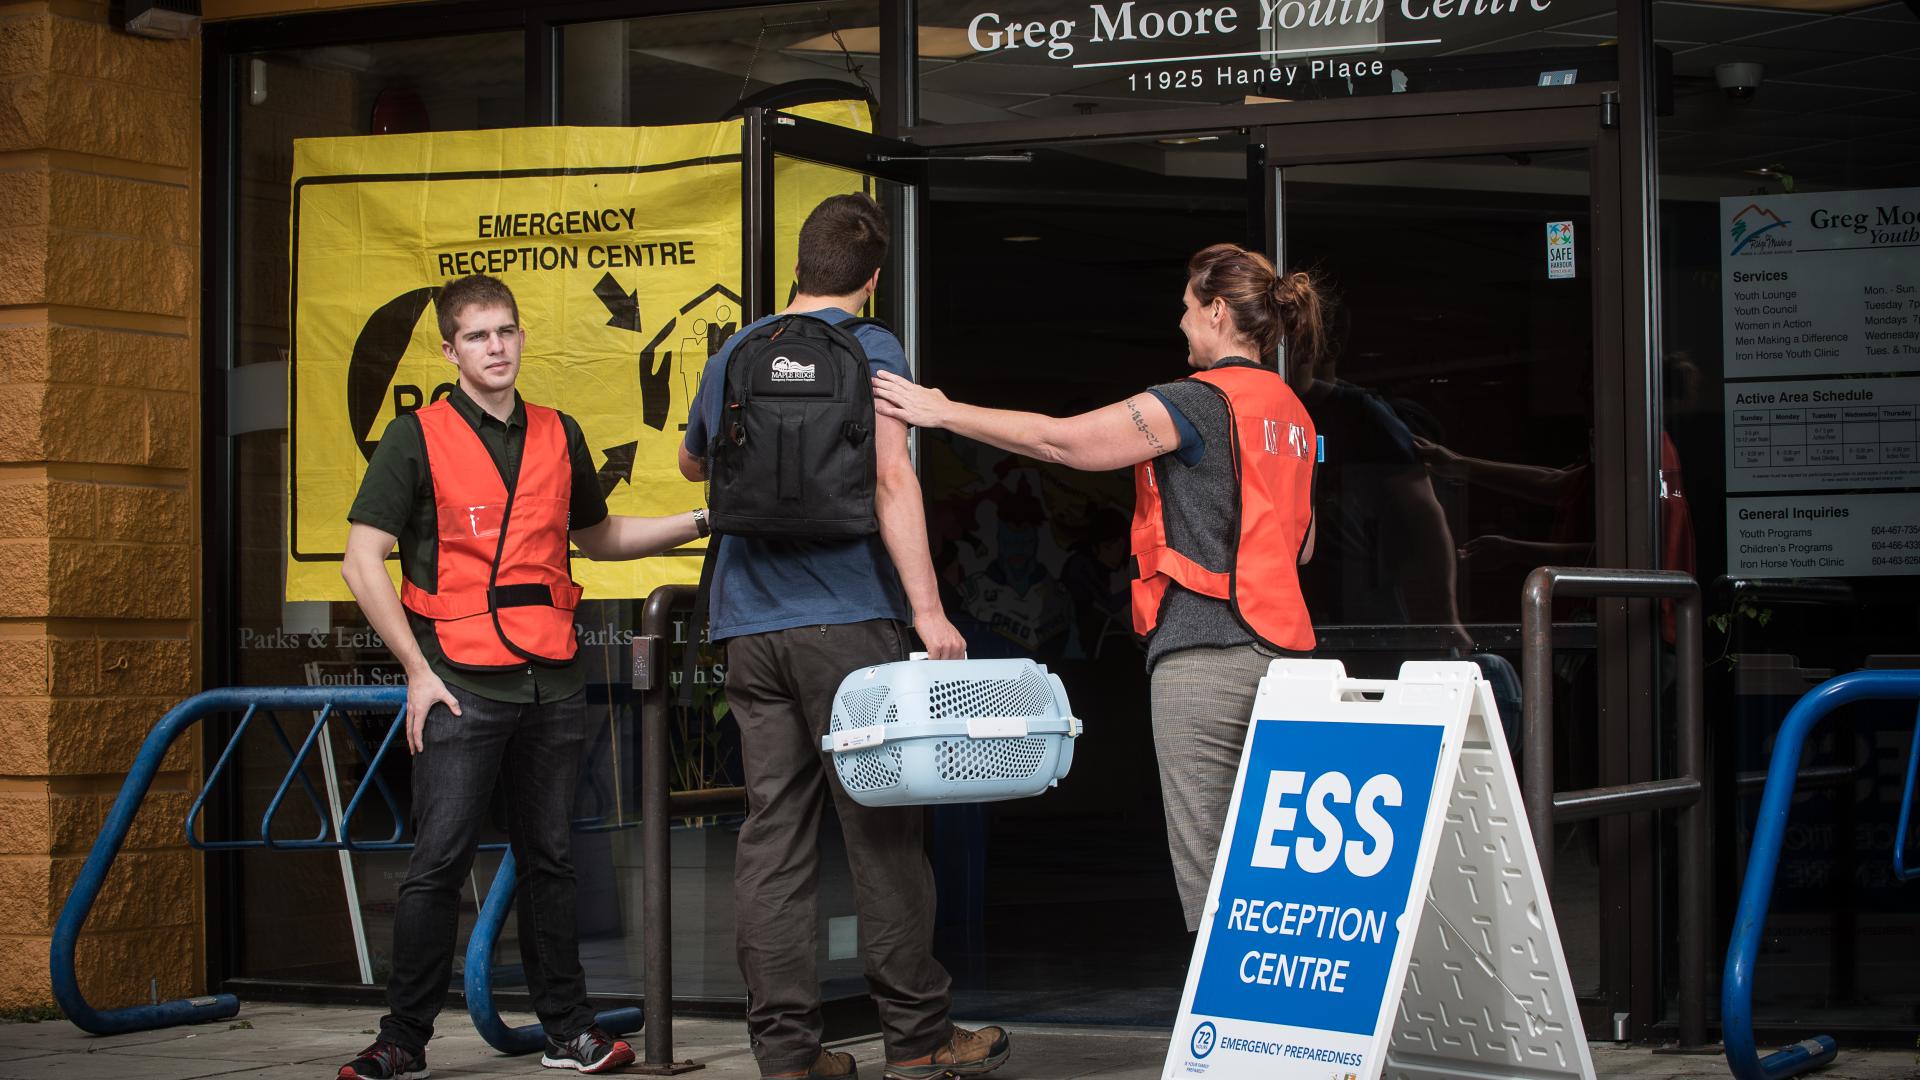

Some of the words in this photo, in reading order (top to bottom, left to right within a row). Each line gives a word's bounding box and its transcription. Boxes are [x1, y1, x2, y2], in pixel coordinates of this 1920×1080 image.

[967, 12, 1076, 60] Greg
[1089, 2, 1238, 43] Moore
[1128, 69, 1203, 92] 11925
[1217, 65, 1297, 87] Haney
[1311, 59, 1384, 79] Place
[478, 208, 636, 238] EMERGENCY
[1810, 209, 1869, 234] Greg
[1870, 226, 1920, 244] Youth
[438, 246, 578, 276] RECEPTION
[587, 241, 696, 269] CENTRE
[1550, 247, 1572, 262] SAFE
[1733, 270, 1788, 283] Services
[1734, 290, 1760, 301] Youth
[1762, 289, 1797, 301] Lounge
[1734, 305, 1760, 316] Youth
[1762, 304, 1797, 315] Council
[1864, 300, 1903, 311] Tuesday
[1772, 320, 1781, 329] in
[1783, 319, 1812, 329] Action
[1864, 315, 1907, 326] Mondays
[1735, 336, 1755, 346] Men
[1757, 334, 1791, 346] Making
[1801, 333, 1849, 344] Difference
[1735, 351, 1753, 361] Iron
[1756, 350, 1783, 360] Horse
[1785, 348, 1812, 359] Youth
[1814, 347, 1840, 358] Clinic
[771, 371, 794, 379] MAPLE
[794, 371, 816, 379] RIDGE
[1735, 392, 1775, 405] Active
[1779, 391, 1809, 403] Area
[1812, 389, 1873, 402] Schedule
[1775, 413, 1800, 421] Monday
[1883, 409, 1912, 417] Thursday
[1738, 508, 1789, 520] General
[1793, 506, 1849, 520] Inquiries
[1739, 529, 1765, 539] Youth
[1767, 528, 1812, 540] Programs
[1740, 544, 1786, 555] Children's
[1788, 543, 1833, 555] Programs
[1740, 559, 1758, 569] Iron
[1760, 559, 1788, 569] Horse
[1790, 558, 1816, 568] Youth
[1818, 557, 1845, 567] Clinic
[239, 626, 300, 650] Parks
[307, 626, 328, 649] &
[315, 666, 365, 686] outh
[1250, 769, 1403, 878] ESS
[1227, 898, 1387, 944] RECEPTION
[1239, 950, 1350, 993] CENTRE
[1197, 1031, 1211, 1045] 72
[1220, 1036, 1283, 1057] EMERGENCY
[1284, 1044, 1363, 1067] PREPAREDNESS
